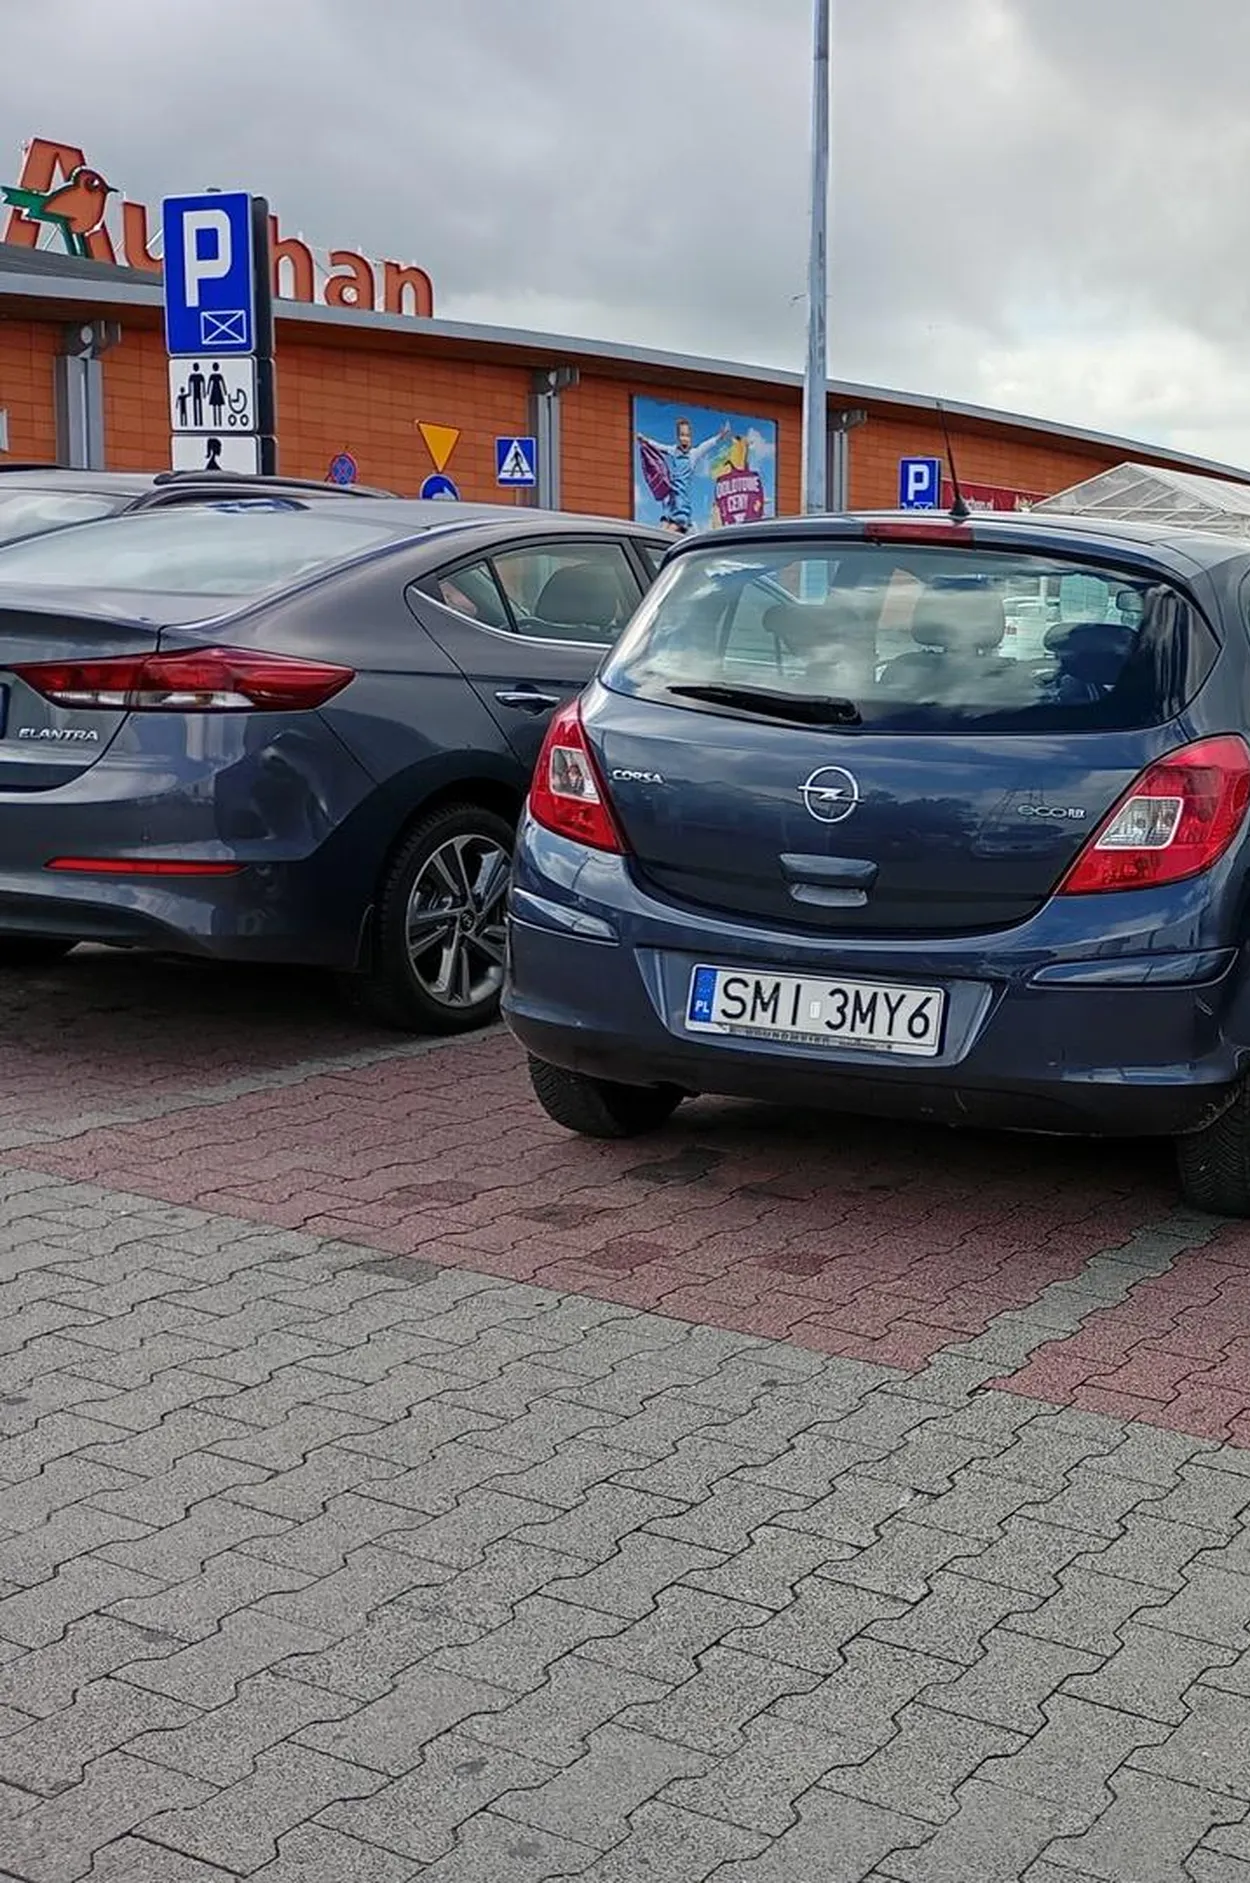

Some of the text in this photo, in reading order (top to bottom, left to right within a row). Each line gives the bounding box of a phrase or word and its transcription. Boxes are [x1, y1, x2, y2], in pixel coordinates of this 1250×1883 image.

[4, 137, 434, 317] Auhan
[182, 209, 232, 307] P
[907, 463, 930, 501] P
[18, 727, 98, 742] ELANTRA
[612, 769, 664, 784] CORSA
[694, 999, 711, 1015] PL
[720, 977, 934, 1040] SMI 3MY6
